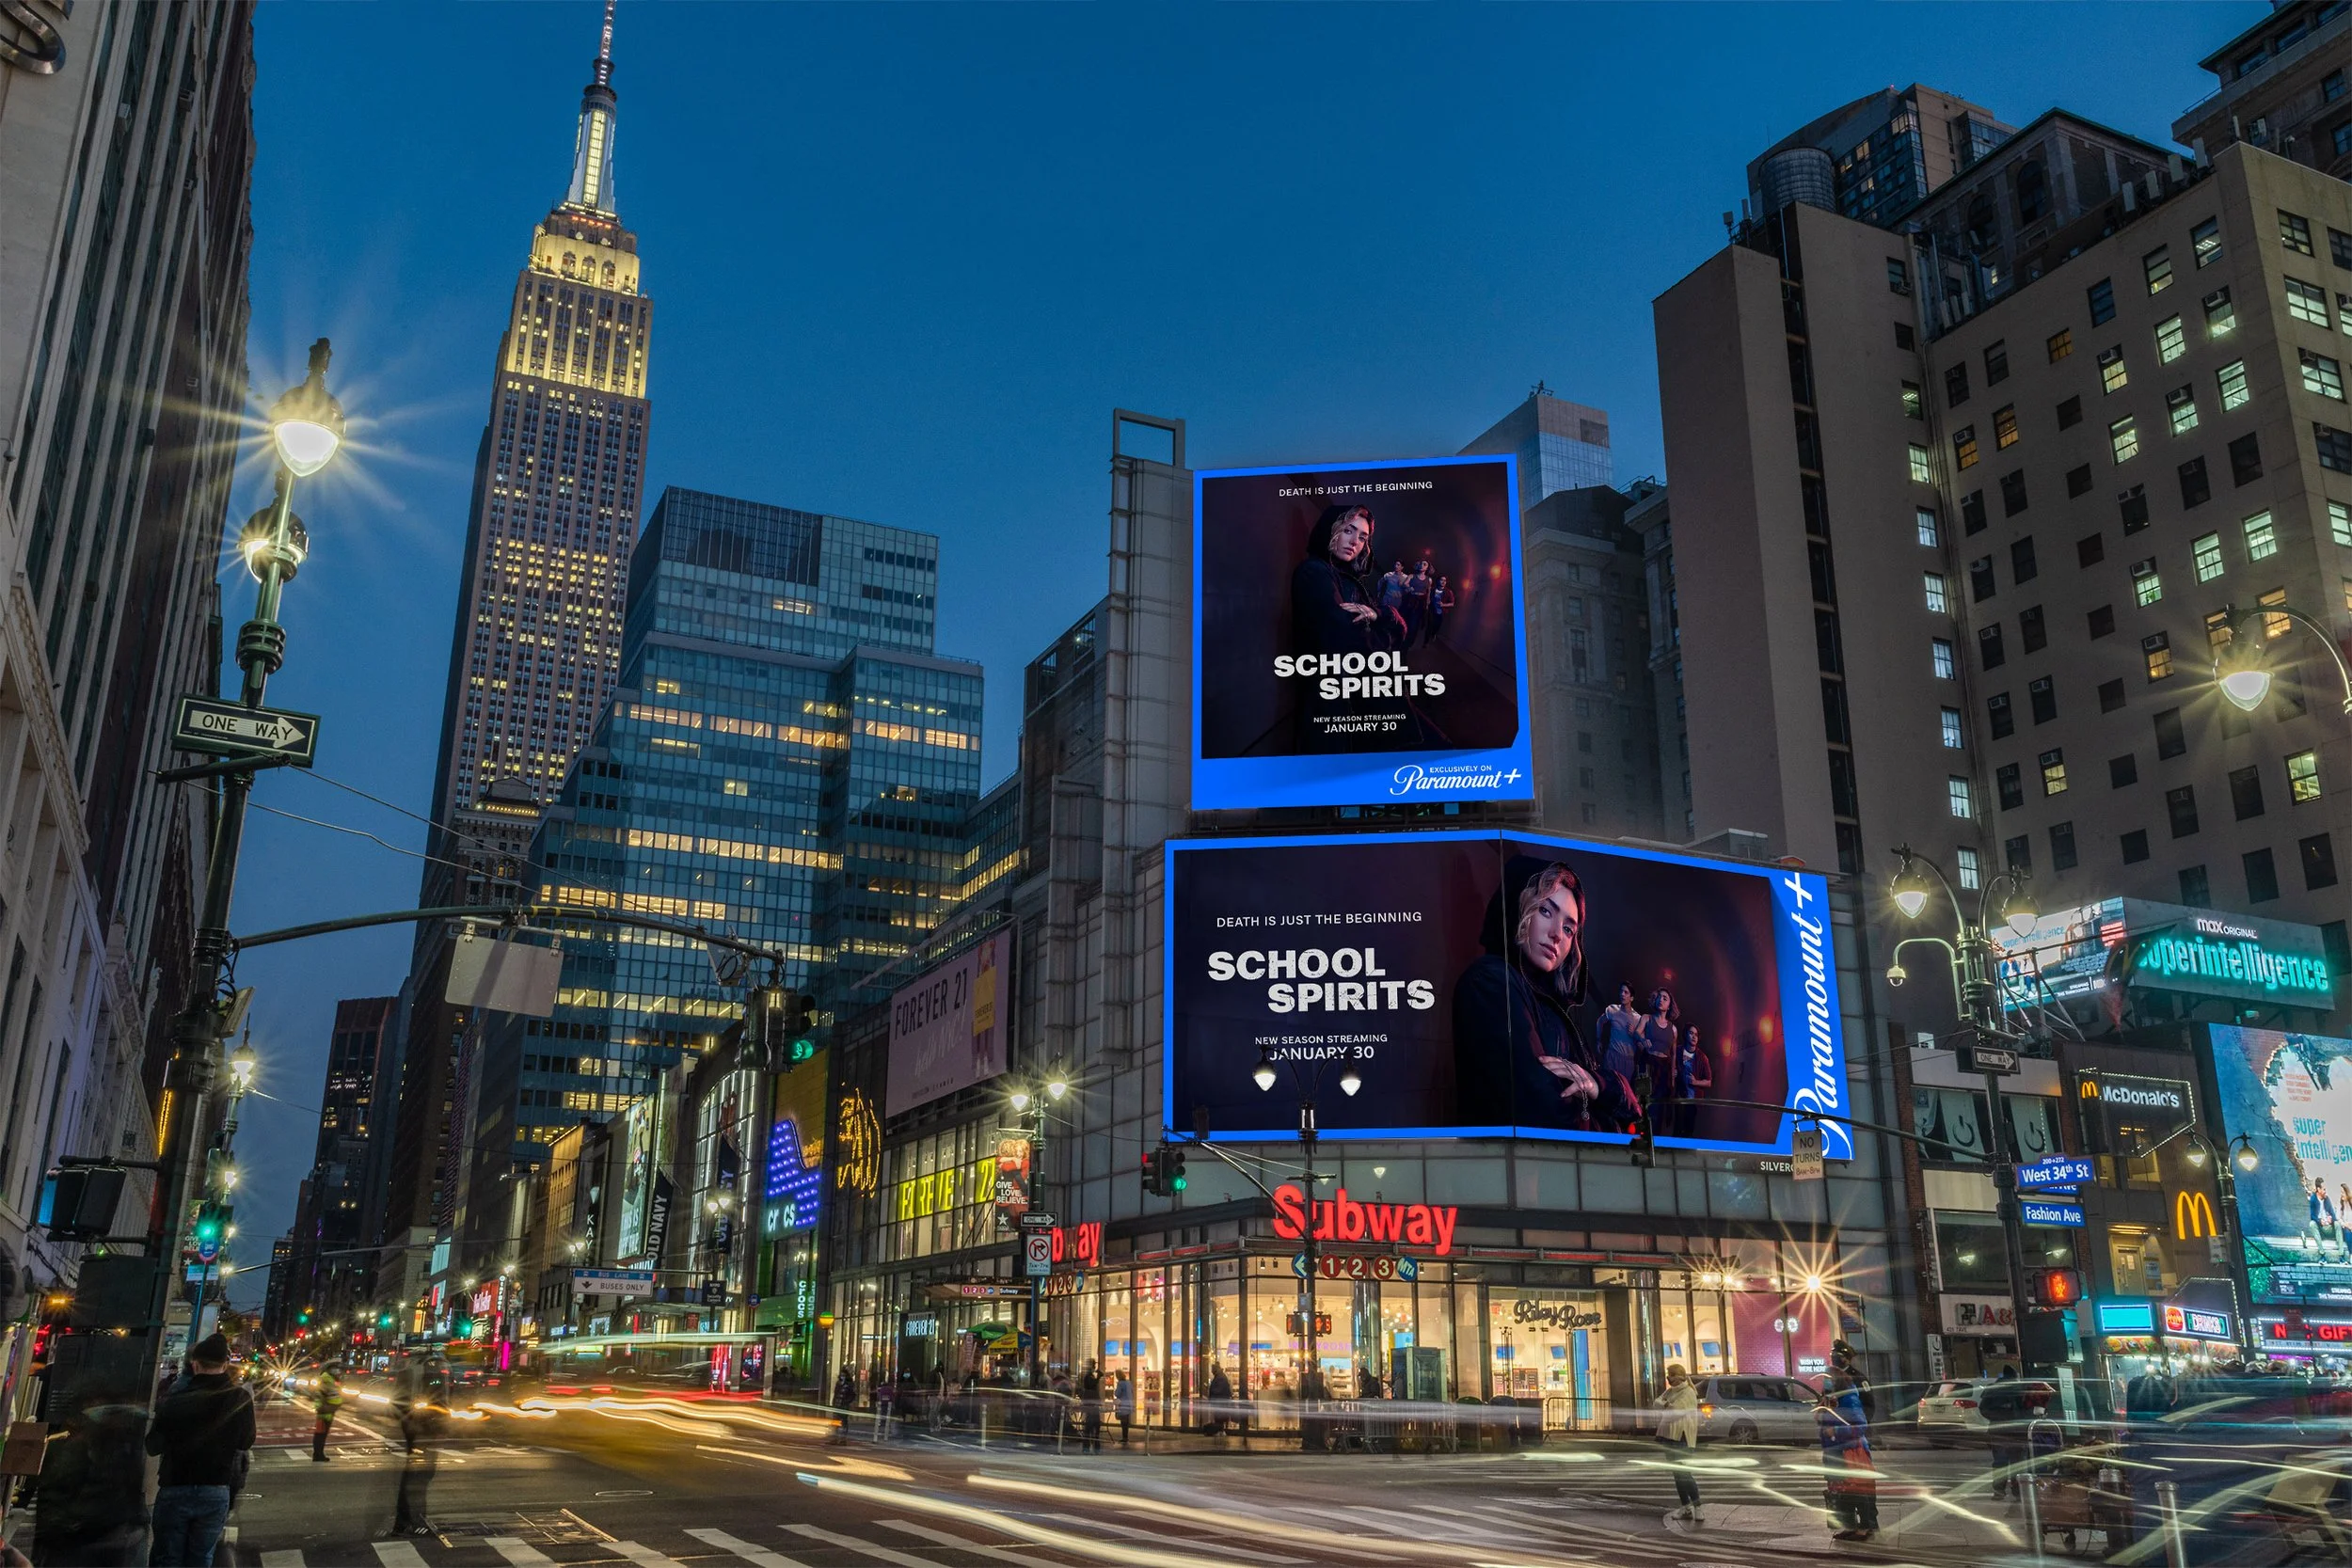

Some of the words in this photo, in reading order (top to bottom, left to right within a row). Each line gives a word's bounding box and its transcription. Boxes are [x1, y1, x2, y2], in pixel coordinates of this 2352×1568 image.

[1279, 488, 1311, 497] DEATH
[1314, 486, 1324, 495] IS
[1327, 485, 1350, 494] JUST
[1353, 483, 1373, 493] THE
[1375, 481, 1433, 491] BEGINNING
[1273, 651, 1408, 677] SCHOOL
[1319, 673, 1446, 700] SPIRITS
[202, 714, 238, 733] ONE
[255, 721, 294, 740] WAY
[1324, 722, 1378, 734] JANUARY
[1381, 722, 1397, 731] 30
[1364, 714, 1406, 722] STREAMING
[1390, 764, 1521, 796] Paramount+
[1216, 915, 1260, 927] DEATH
[1264, 915, 1277, 926] IS
[1280, 914, 1311, 926] JUST
[1315, 913, 1342, 925] THE
[1345, 911, 1422, 924] BEGINNING
[2197, 918, 2223, 934] max
[1208, 947, 1386, 981] SCHOOL
[895, 979, 948, 1040] FOREVER
[954, 968, 968, 1010] 21
[1267, 979, 1435, 1013] SPIRITS
[1255, 1036, 1278, 1045] NEW
[1281, 1036, 1324, 1045] SEASON
[1327, 1034, 1388, 1044] STREAMING
[1269, 1046, 1347, 1061] JANUARY
[1353, 1045, 1375, 1059] 30
[1980, 1054, 1993, 1063] ONE
[1997, 1055, 2010, 1065] WAY
[2103, 1085, 2180, 1108] McDonald's
[2293, 1117, 2327, 1137] super
[1800, 1137, 1815, 1148] NO
[1795, 1152, 1820, 1164] TURNS
[2022, 1167, 2052, 1183] West
[2052, 1164, 2074, 1180] 34th
[2075, 1164, 2090, 1178] St
[652, 1195, 667, 1233] NAVY
[1273, 1184, 1457, 1256] Subway
[2025, 1206, 2061, 1222] Fashion
[2063, 1209, 2081, 1223] Ave
[585, 1214, 595, 1250] KAY
[645, 1235, 660, 1261] OLD
[1352, 1259, 1363, 1275] 2
[1378, 1259, 1390, 1275] 3
[798, 1280, 807, 1319] crocs
[1514, 1298, 1558, 1327] Riley
[1558, 1305, 1602, 1330] Rose
[905, 1320, 928, 1338] FOREVER
[928, 1319, 936, 1336] 21
